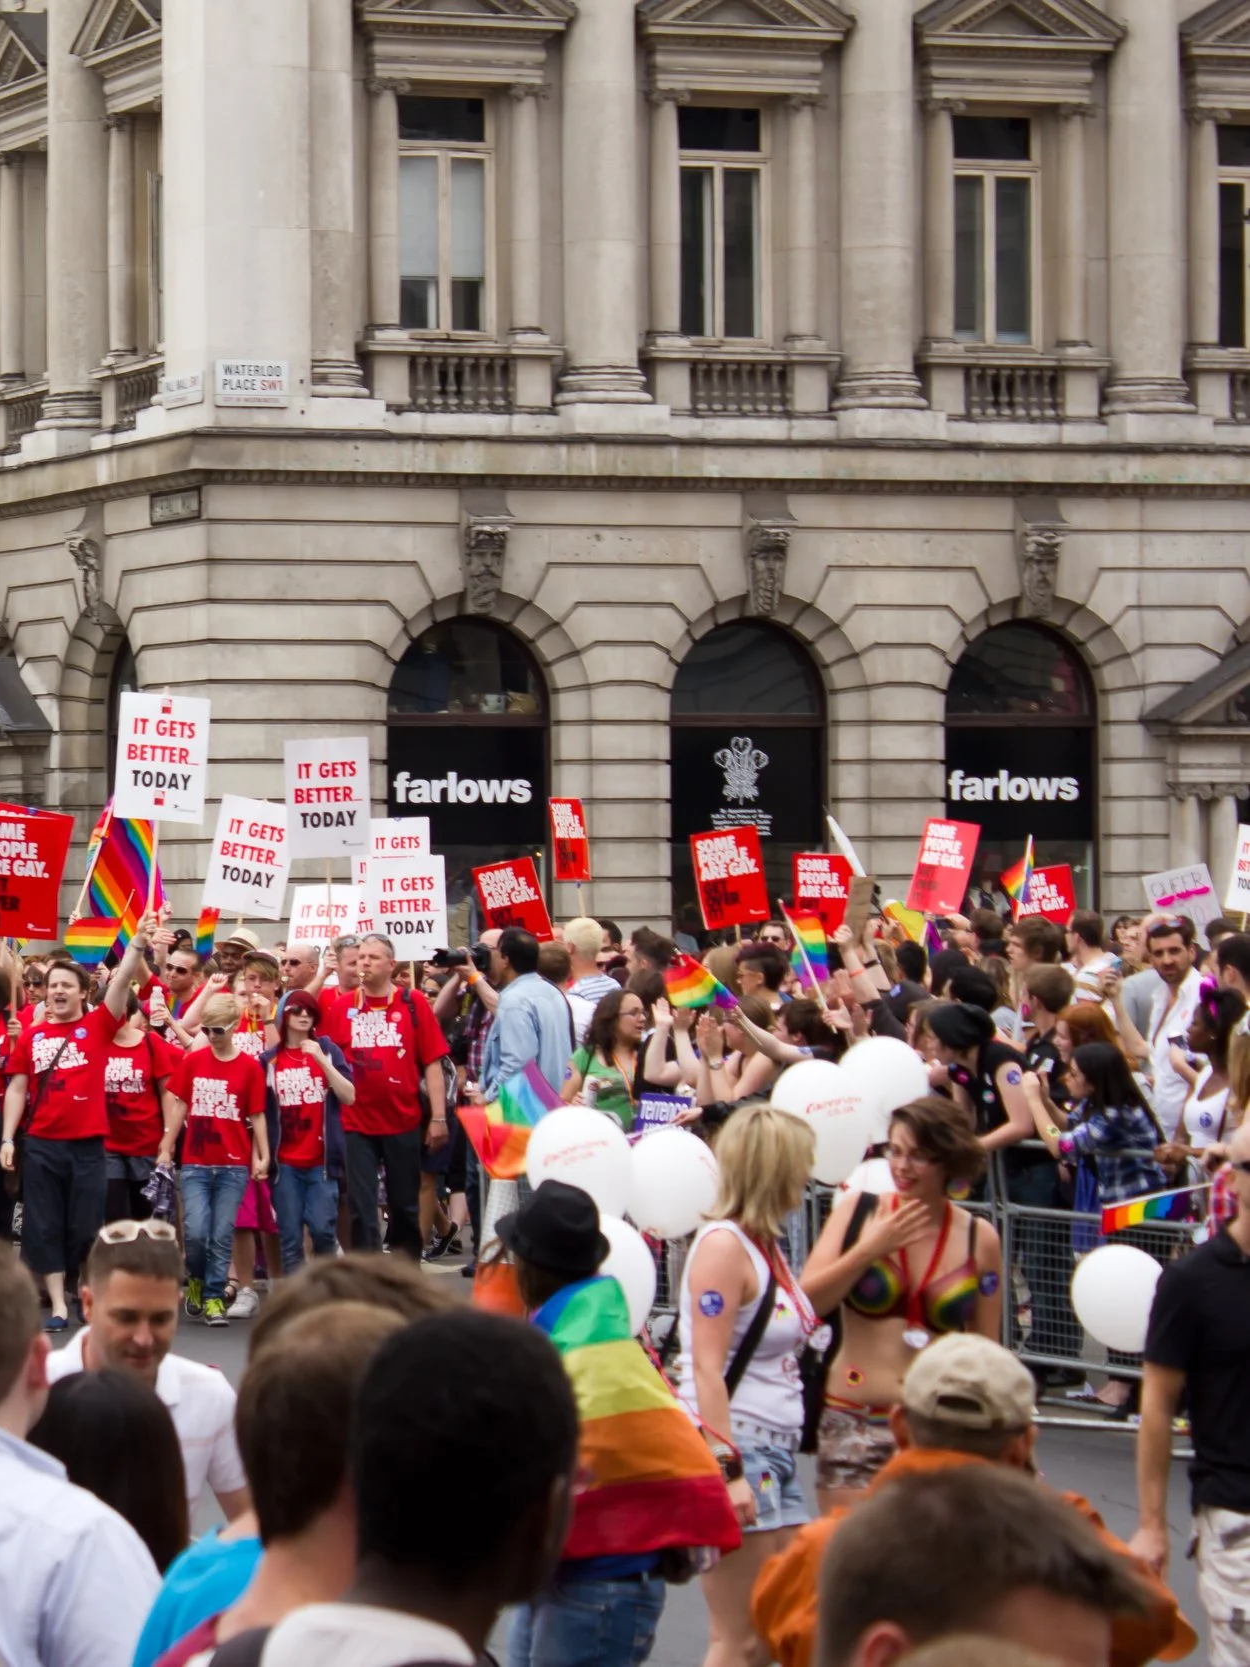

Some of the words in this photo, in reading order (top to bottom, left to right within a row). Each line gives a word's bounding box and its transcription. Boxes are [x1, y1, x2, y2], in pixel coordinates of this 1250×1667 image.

[222, 364, 282, 376] WATERLOO
[222, 379, 256, 390] PLACE
[260, 380, 284, 391] SW1
[134, 717, 149, 735] IT
[156, 719, 195, 739] GETS
[298, 763, 312, 779] IT
[319, 760, 357, 779] GETS
[132, 769, 192, 791] TODAY
[393, 771, 532, 804] farlows
[948, 769, 1080, 801] farlows
[300, 810, 357, 829] TODAY
[229, 818, 244, 835] IT
[248, 822, 285, 843] GETS
[375, 837, 386, 850] IT
[391, 836, 420, 849] GETS
[696, 835, 736, 853] SOME
[697, 846, 750, 868] PEOPLE
[797, 858, 830, 872] SOME
[12, 860, 50, 878] GAY.
[222, 864, 275, 889] TODAY
[478, 867, 514, 884] SOME
[701, 860, 729, 881] ARE
[729, 858, 760, 876] GAY.
[382, 879, 395, 892] IT
[401, 876, 434, 891] GETS
[798, 871, 840, 885] PEOPLE
[1029, 872, 1047, 887] ME
[479, 877, 527, 897] PEOPLE
[798, 884, 821, 897] ARE
[821, 885, 848, 898] GAY.
[1030, 884, 1058, 901] OPLE
[487, 895, 511, 910] ARE
[511, 887, 539, 904] GAY.
[1041, 895, 1069, 911] GAY.
[301, 905, 310, 918] IT
[316, 904, 348, 918] GETS
[385, 920, 434, 935] TODAY
[351, 1022, 397, 1037] PEOPLE
[351, 1035, 375, 1048] ARE
[376, 1034, 403, 1047] GAY.
[105, 1065, 143, 1081] EOPLE
[276, 1067, 310, 1081] SOME
[105, 1081, 120, 1092] RE
[193, 1077, 228, 1090] SOME
[277, 1077, 323, 1093] PEOPLE
[192, 1089, 237, 1107] PEOPLE
[191, 1103, 214, 1117] ARE
